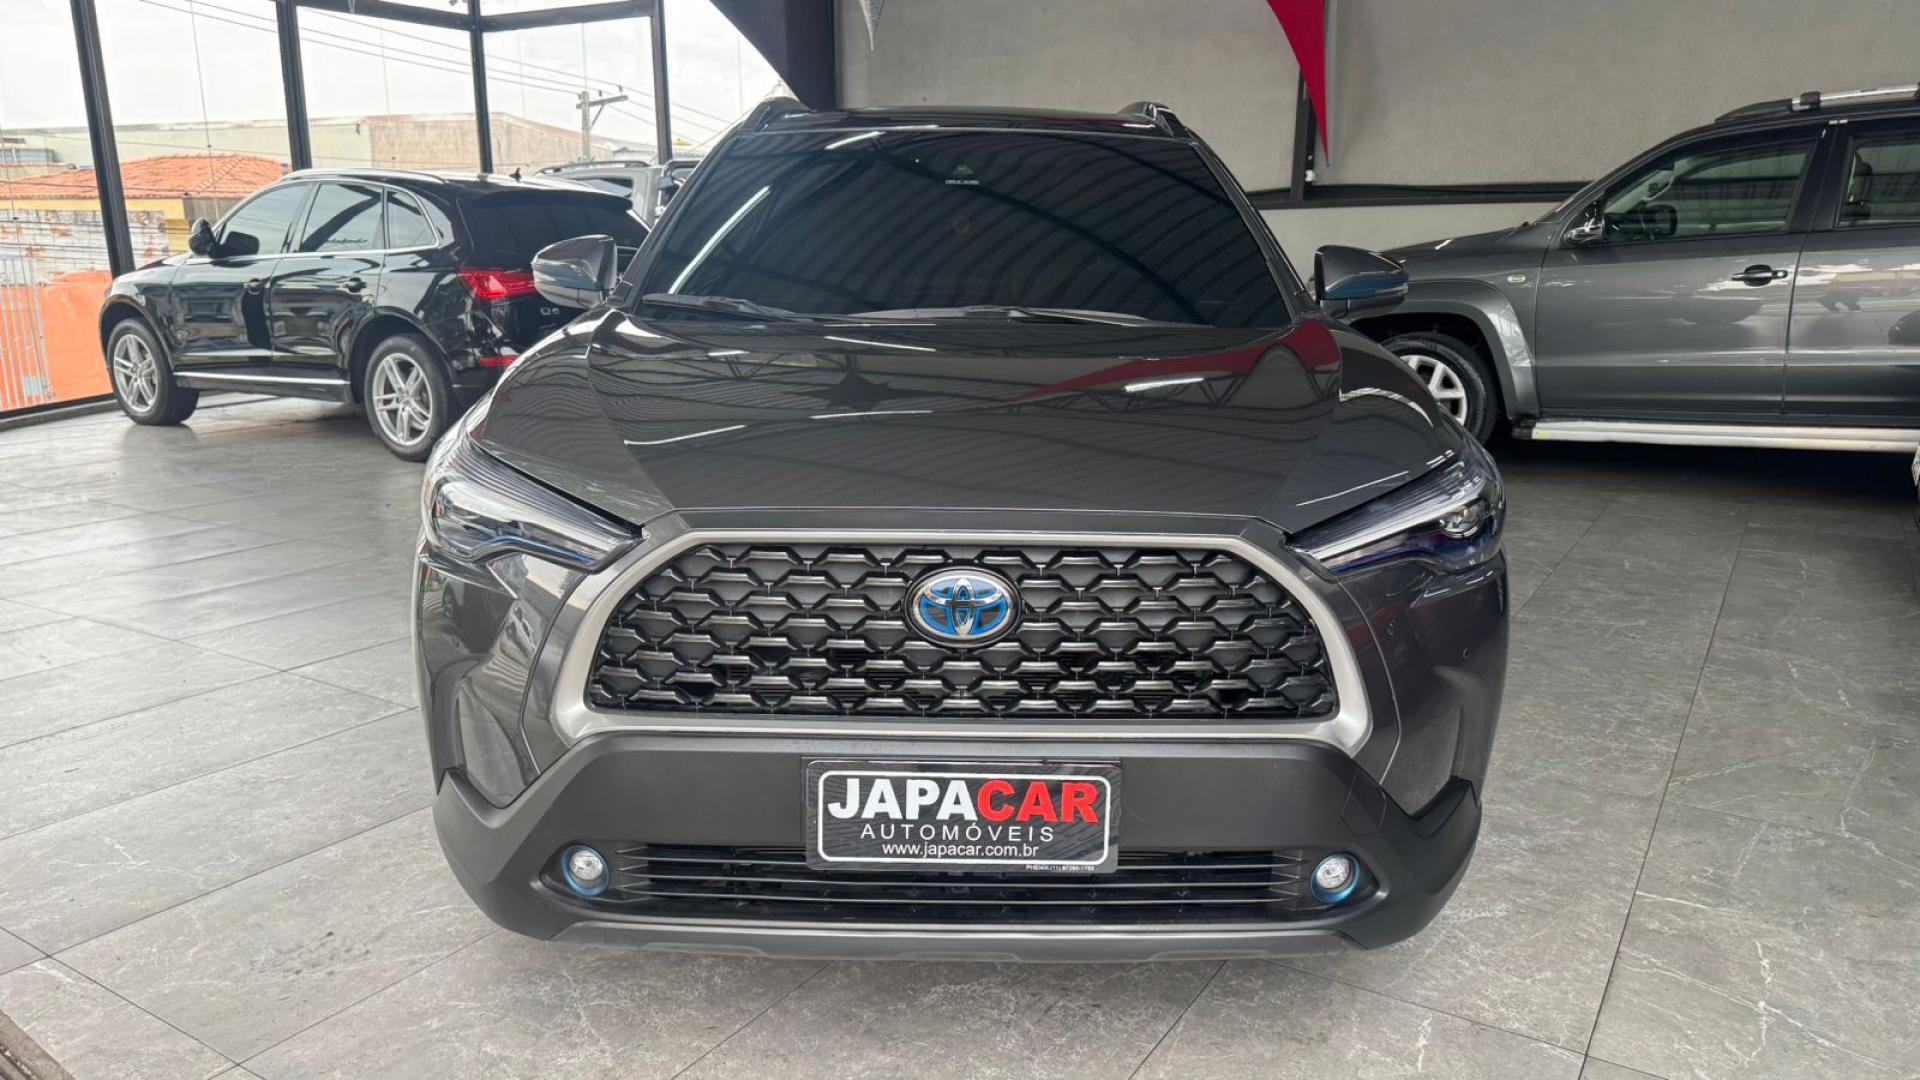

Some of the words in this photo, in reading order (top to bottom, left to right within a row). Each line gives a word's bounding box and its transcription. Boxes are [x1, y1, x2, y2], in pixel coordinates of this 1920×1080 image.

[828, 778, 1099, 823] JAPACAR
[860, 823, 1054, 842] AUTOMÓVEIS
[882, 842, 1039, 858] www.japacar.com.br
